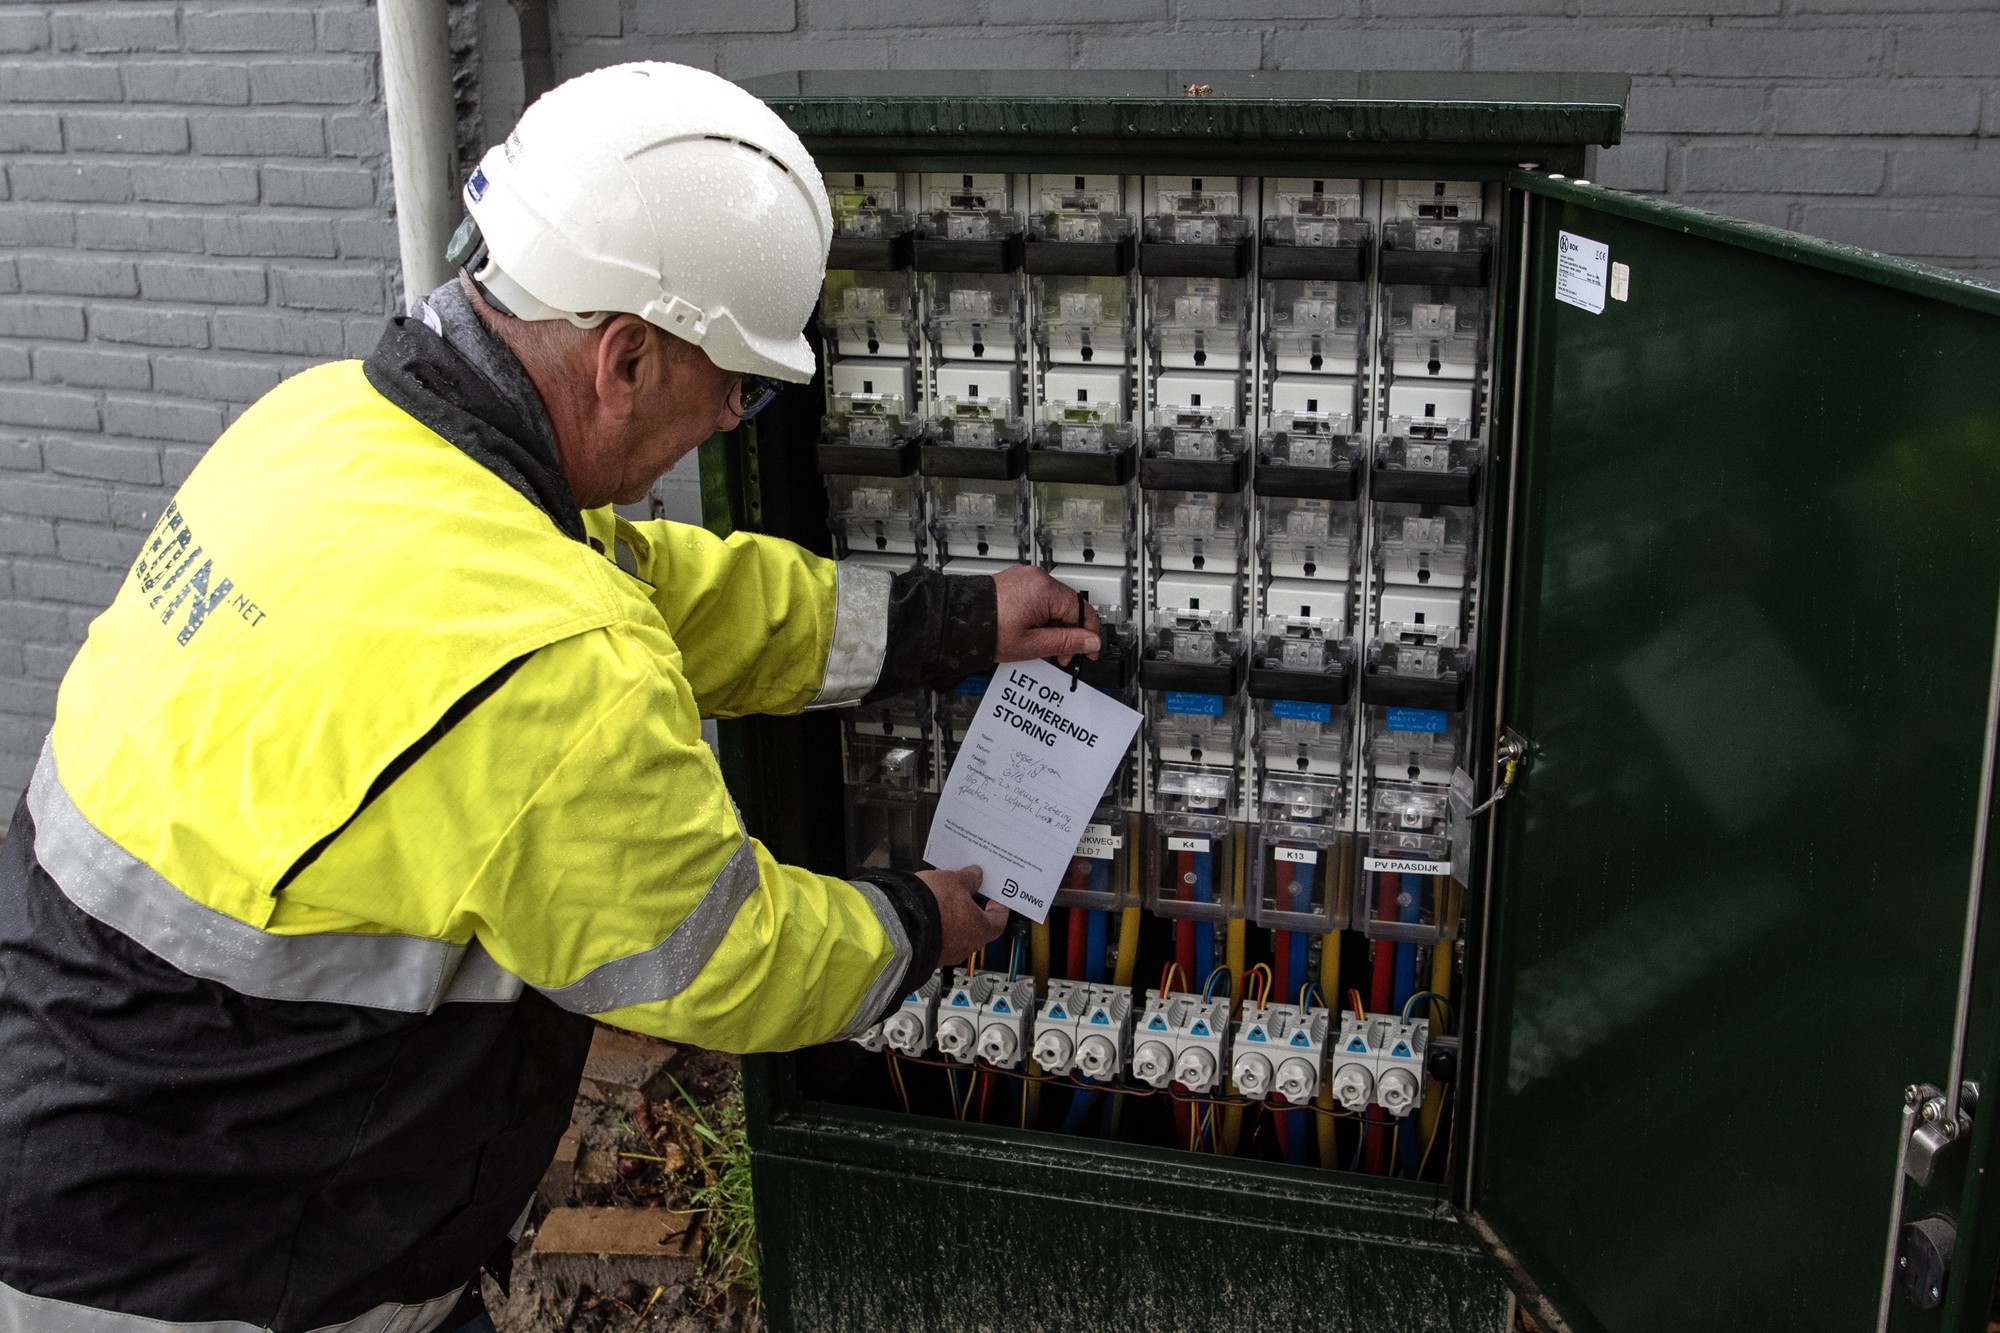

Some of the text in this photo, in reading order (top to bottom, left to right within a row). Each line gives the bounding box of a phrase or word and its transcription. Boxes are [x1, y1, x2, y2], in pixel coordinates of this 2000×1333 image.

[1009, 669, 1038, 692] LET
[1038, 686, 1064, 707] OP!
[1001, 687, 1098, 748] SLUIMERENDE
[993, 705, 1057, 747] STORING
[1084, 826, 1096, 834] ST
[1076, 846, 1094, 855] ELD
[1287, 851, 1304, 860] K13
[1374, 861, 1439, 872] PV PAASDIJK
[1020, 891, 1044, 908] DNWG
